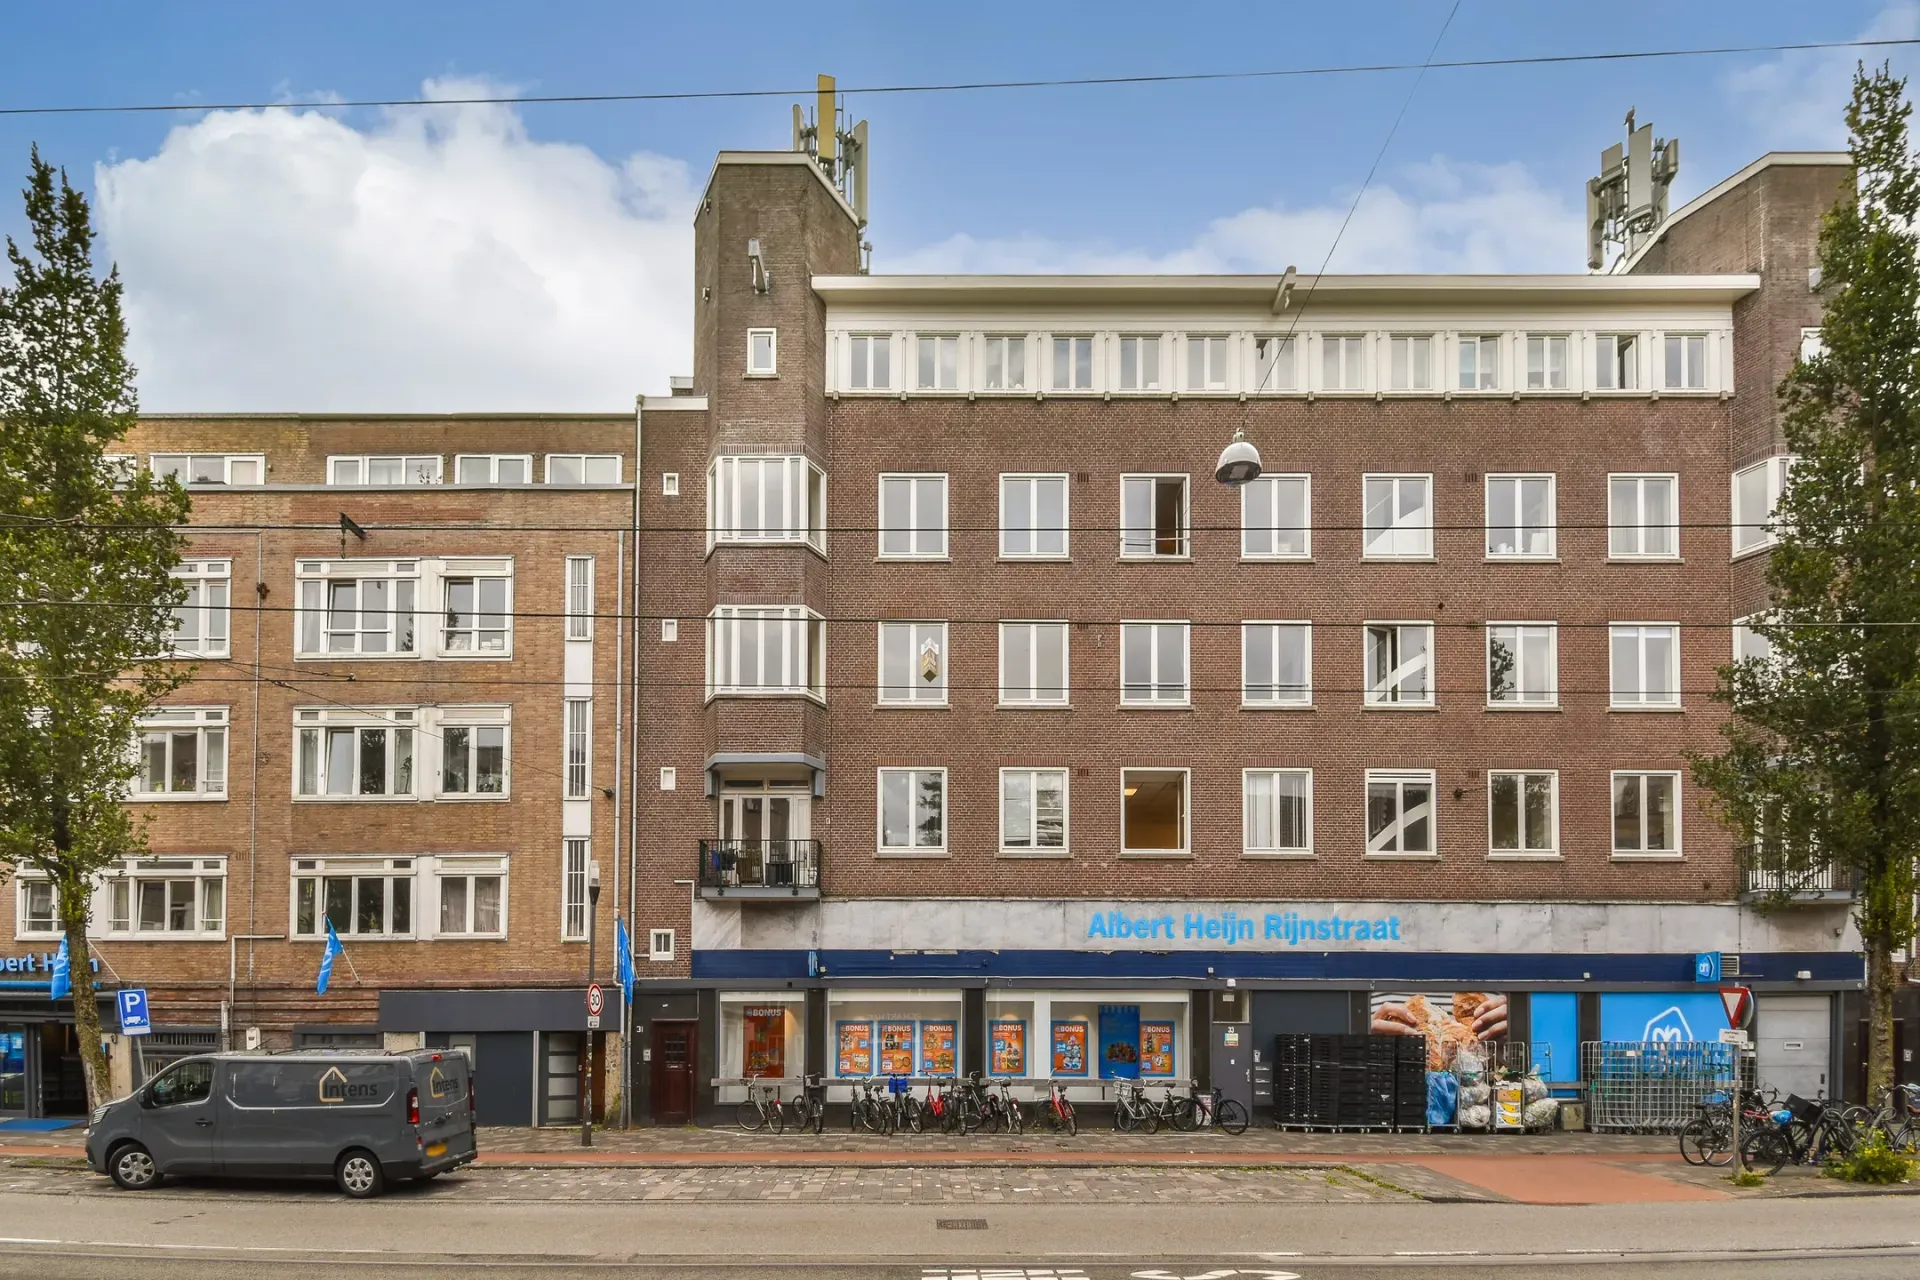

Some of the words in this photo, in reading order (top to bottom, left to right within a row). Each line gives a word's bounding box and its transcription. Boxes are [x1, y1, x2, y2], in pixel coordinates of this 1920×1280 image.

[1087, 911, 1175, 939] Albert
[1184, 911, 1254, 945] Heijn
[1265, 912, 1400, 945] Rijnstraat
[124, 993, 141, 1013] P
[591, 994, 600, 1006] 30
[752, 1009, 782, 1017] BONUS
[998, 1024, 1022, 1032] BONUS
[1060, 1025, 1084, 1033] BONUS
[1147, 1025, 1171, 1033] BONUS
[324, 1082, 378, 1098] Intens
[432, 1077, 460, 1093] Intens
